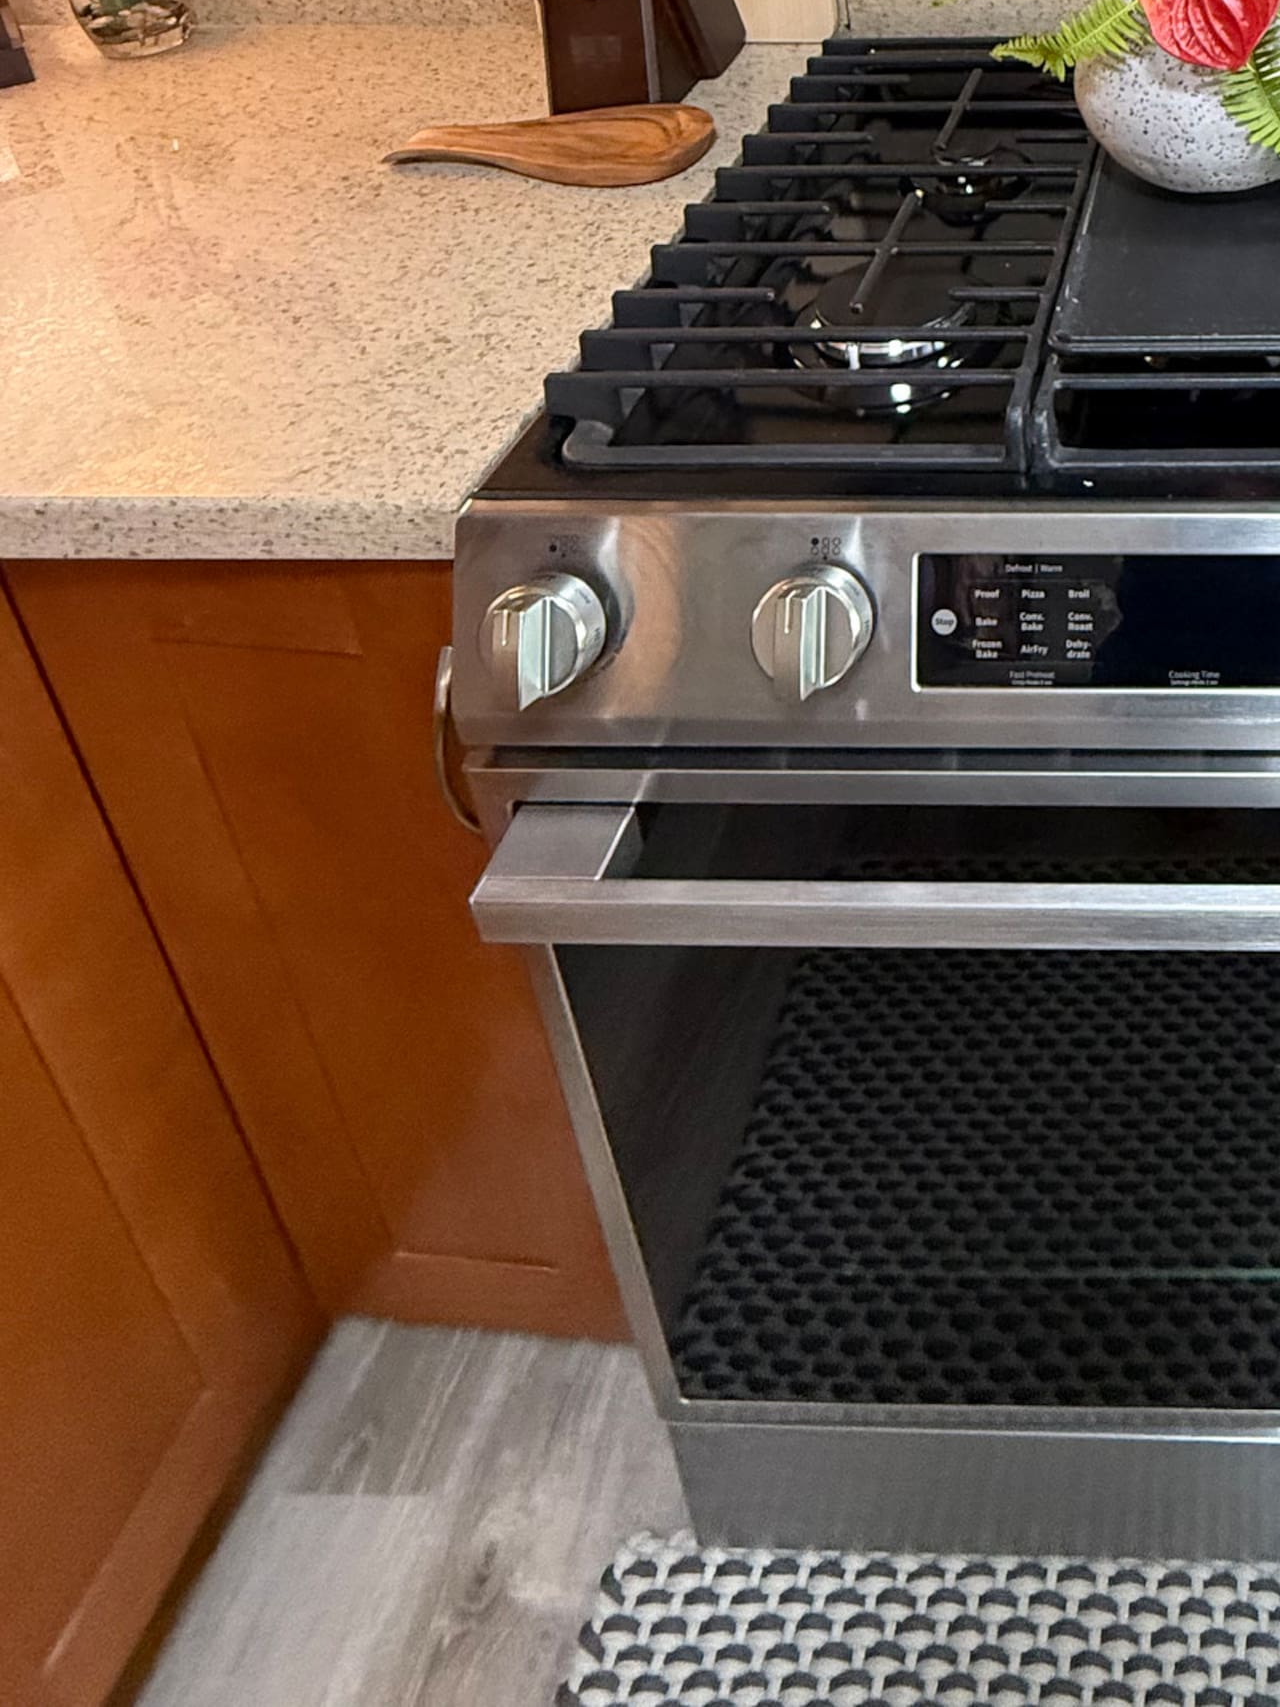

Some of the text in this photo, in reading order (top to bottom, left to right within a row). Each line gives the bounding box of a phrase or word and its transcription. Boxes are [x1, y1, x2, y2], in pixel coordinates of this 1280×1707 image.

[1005, 564, 1032, 573] Defrost
[974, 590, 999, 598] Proof
[1022, 590, 1045, 598] Pizza
[1068, 590, 1090, 598] Broil
[1020, 612, 1044, 621] Conv.
[1068, 612, 1093, 621] Conv.
[934, 617, 954, 627] Stop
[976, 617, 997, 626] Bake
[1068, 622, 1093, 630] Roast
[1021, 622, 1043, 631] Bake
[972, 639, 1002, 648] Frozen
[976, 649, 998, 658] Bake
[1021, 645, 1048, 655] AirFry
[1169, 670, 1200, 680] Cooking
